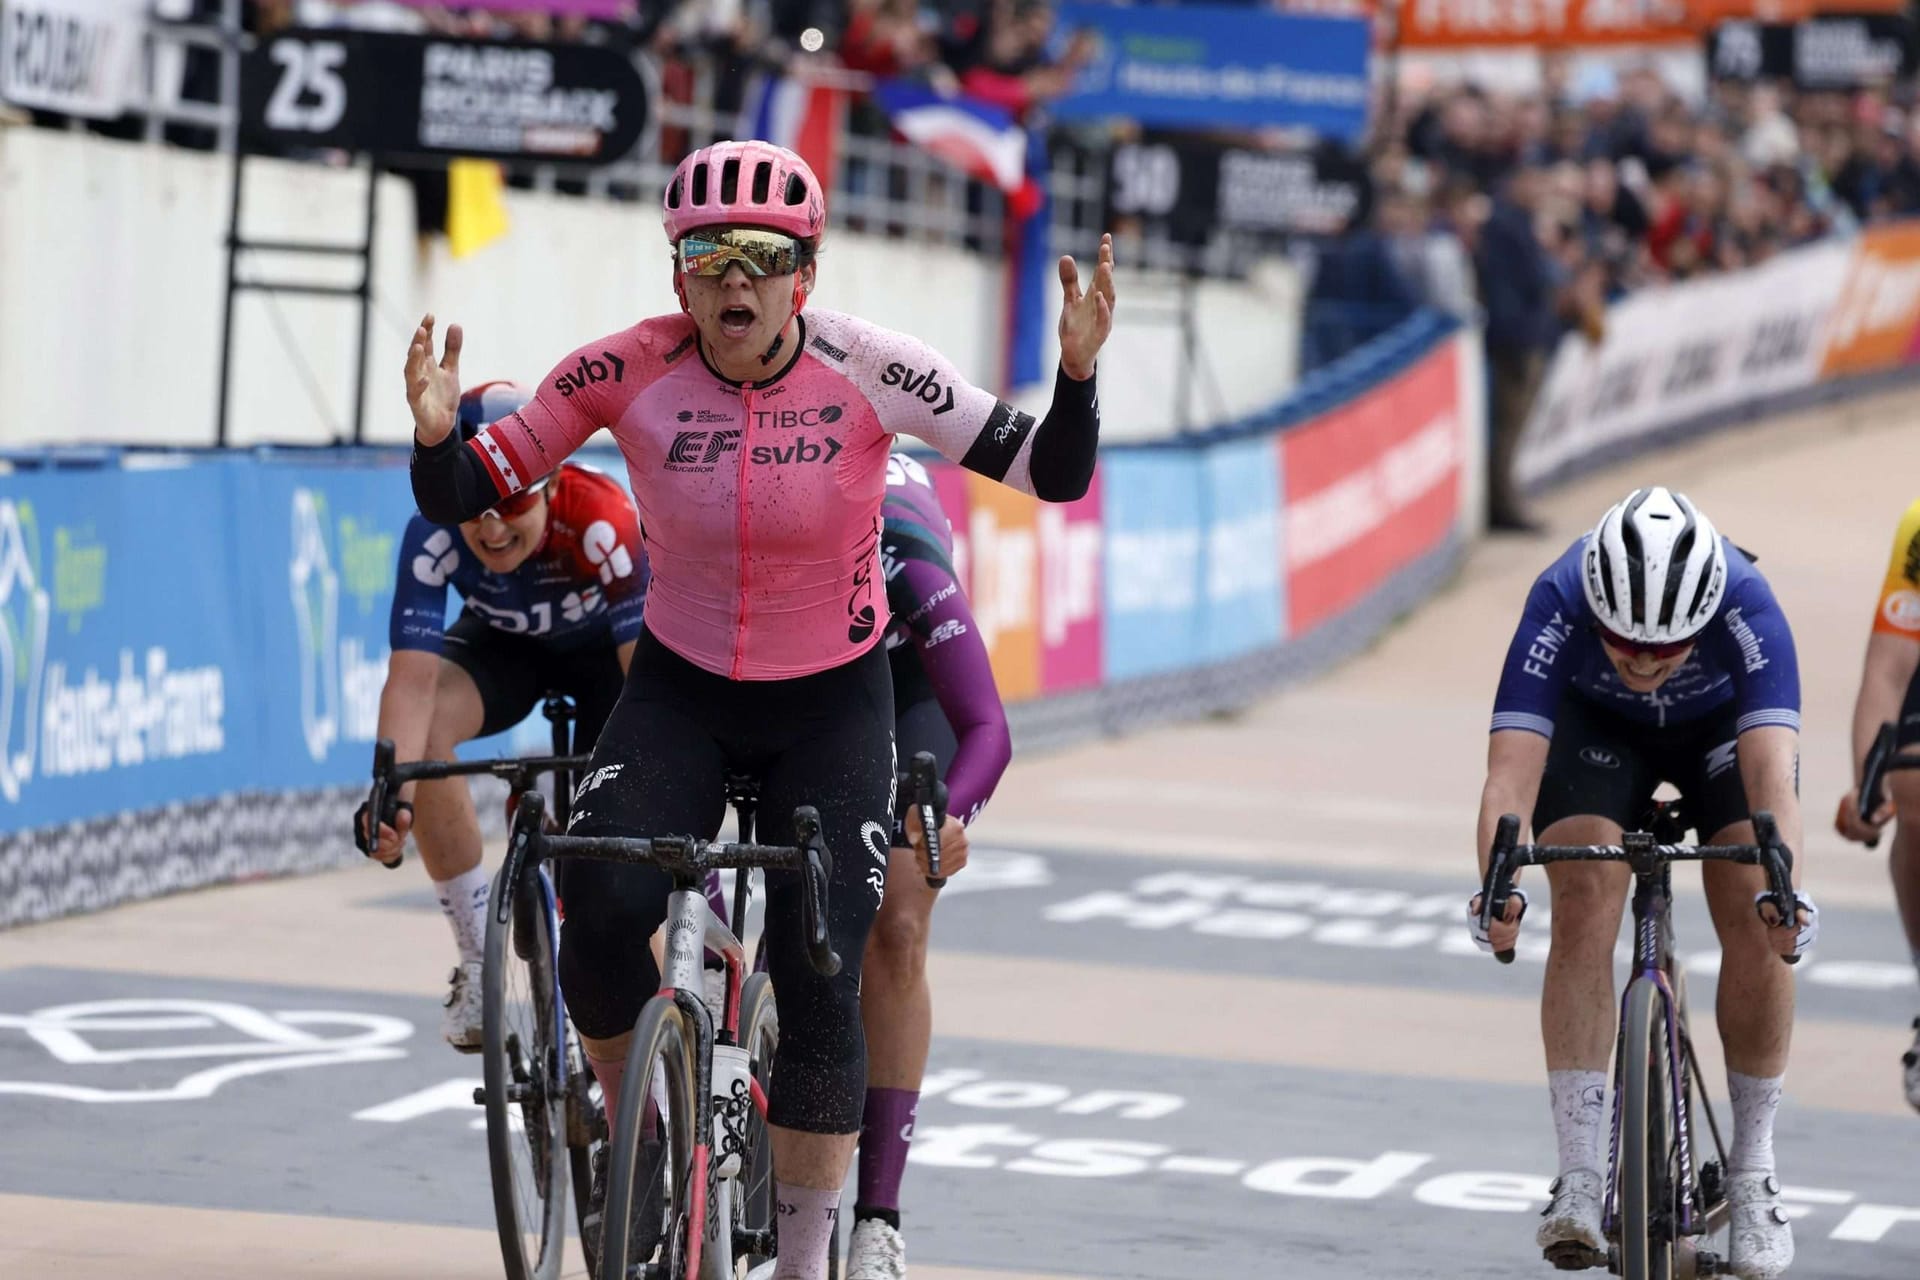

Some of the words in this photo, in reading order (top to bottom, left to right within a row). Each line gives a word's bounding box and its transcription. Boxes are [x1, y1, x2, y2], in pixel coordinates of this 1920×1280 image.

[264, 38, 347, 131] 25
[423, 43, 554, 90] PARIS
[421, 84, 619, 132] ROUBAIX
[554, 356, 608, 397] svb
[881, 362, 943, 403] svb
[663, 462, 715, 473] Education
[666, 429, 743, 463] EF
[750, 437, 821, 465] svb
[1523, 611, 1574, 680] FENIX
[921, 804, 940, 861] SRAM
